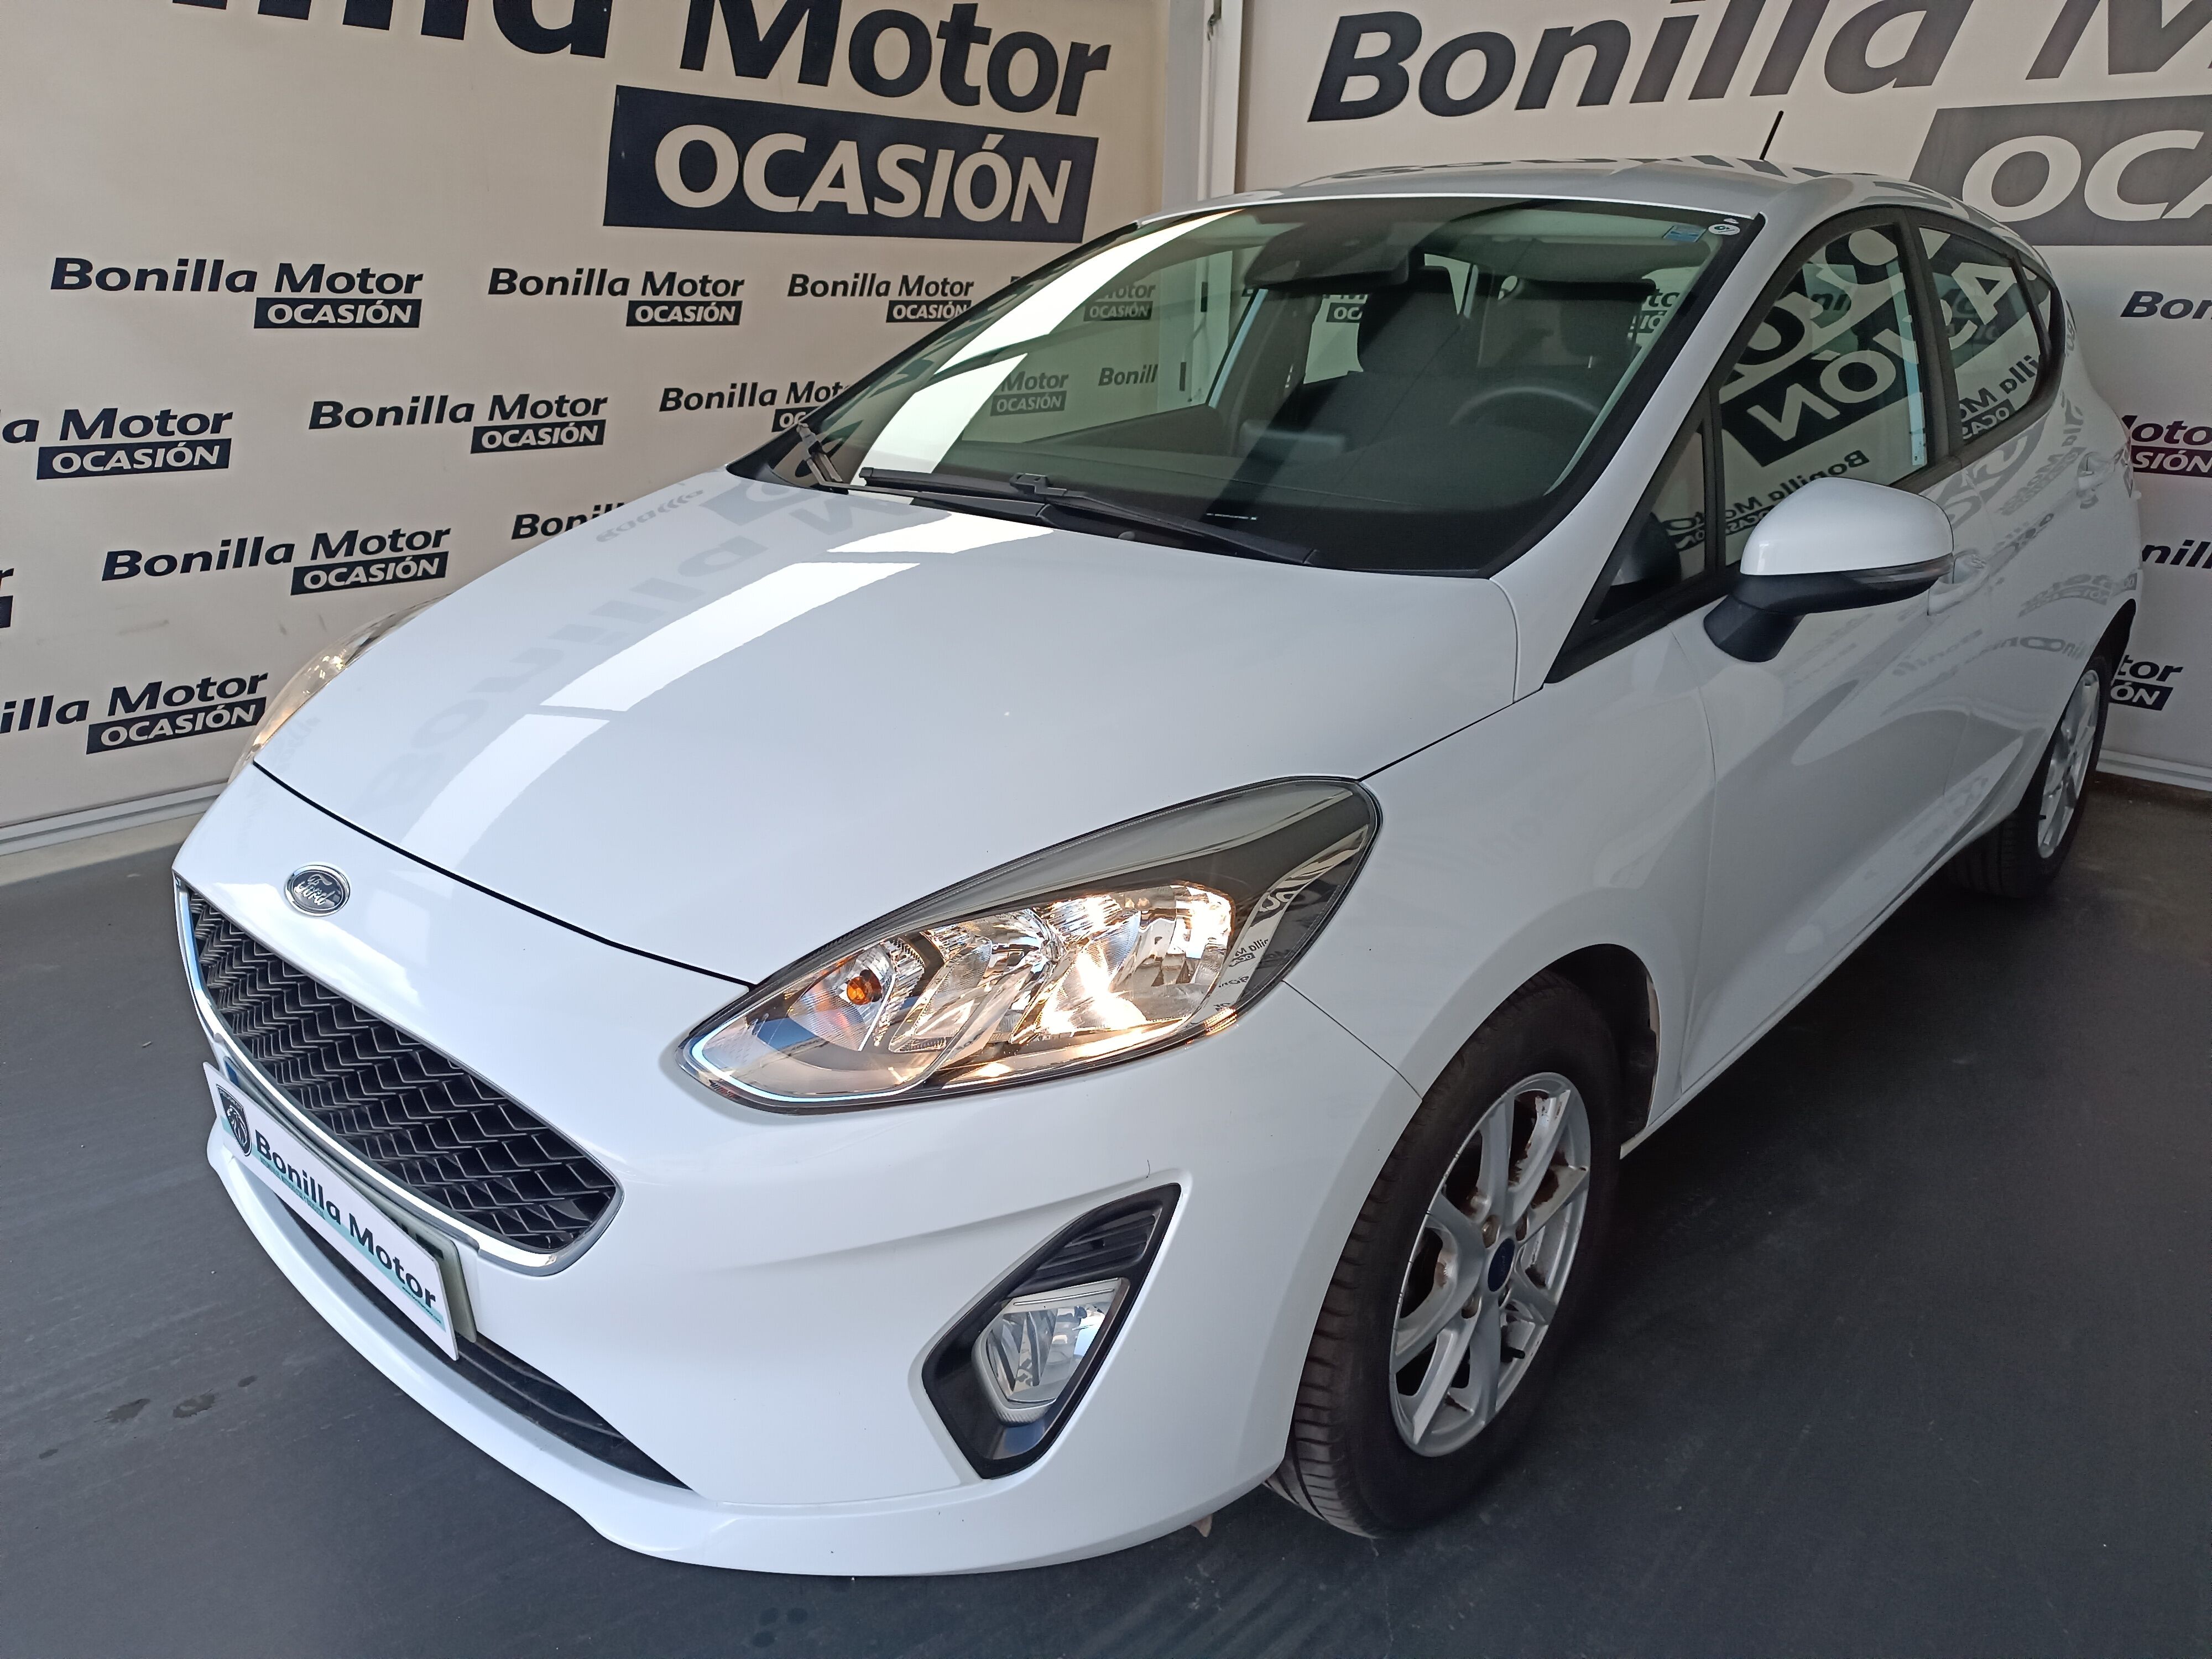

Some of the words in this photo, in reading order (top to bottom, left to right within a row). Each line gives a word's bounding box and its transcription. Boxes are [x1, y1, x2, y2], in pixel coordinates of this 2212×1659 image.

[680, 0, 1112, 116] Motor
[1308, 0, 1974, 122] Bonilla
[655, 124, 1072, 223] OCASIÓN
[51, 257, 258, 292] Bonilla
[274, 263, 424, 294] Motor
[488, 268, 630, 296] Bonilla
[641, 271, 745, 297] Motor
[787, 273, 891, 298] Bonilla
[898, 274, 974, 297] Motor
[268, 300, 413, 325] OCASIÓN
[635, 302, 736, 323] OCASIÓN
[659, 382, 778, 412] Bonilla
[999, 371, 1070, 392] Motor
[309, 394, 475, 430] Bonilla
[487, 393, 608, 421] Motor
[997, 393, 1062, 413] OCASIÓN
[59, 407, 233, 441] Motor
[481, 422, 598, 448] OCASIÓN
[53, 442, 220, 473] OCASIÓN
[101, 536, 295, 581] Bonilla
[310, 528, 451, 561] Motor
[304, 556, 440, 589] OCASIÓN
[107, 672, 269, 717] Motor
[101, 703, 256, 746] OCASIÓN
[293, 873, 335, 906] Ford
[255, 1129, 341, 1225] Bonilla
[349, 1212, 436, 1308] Motor
